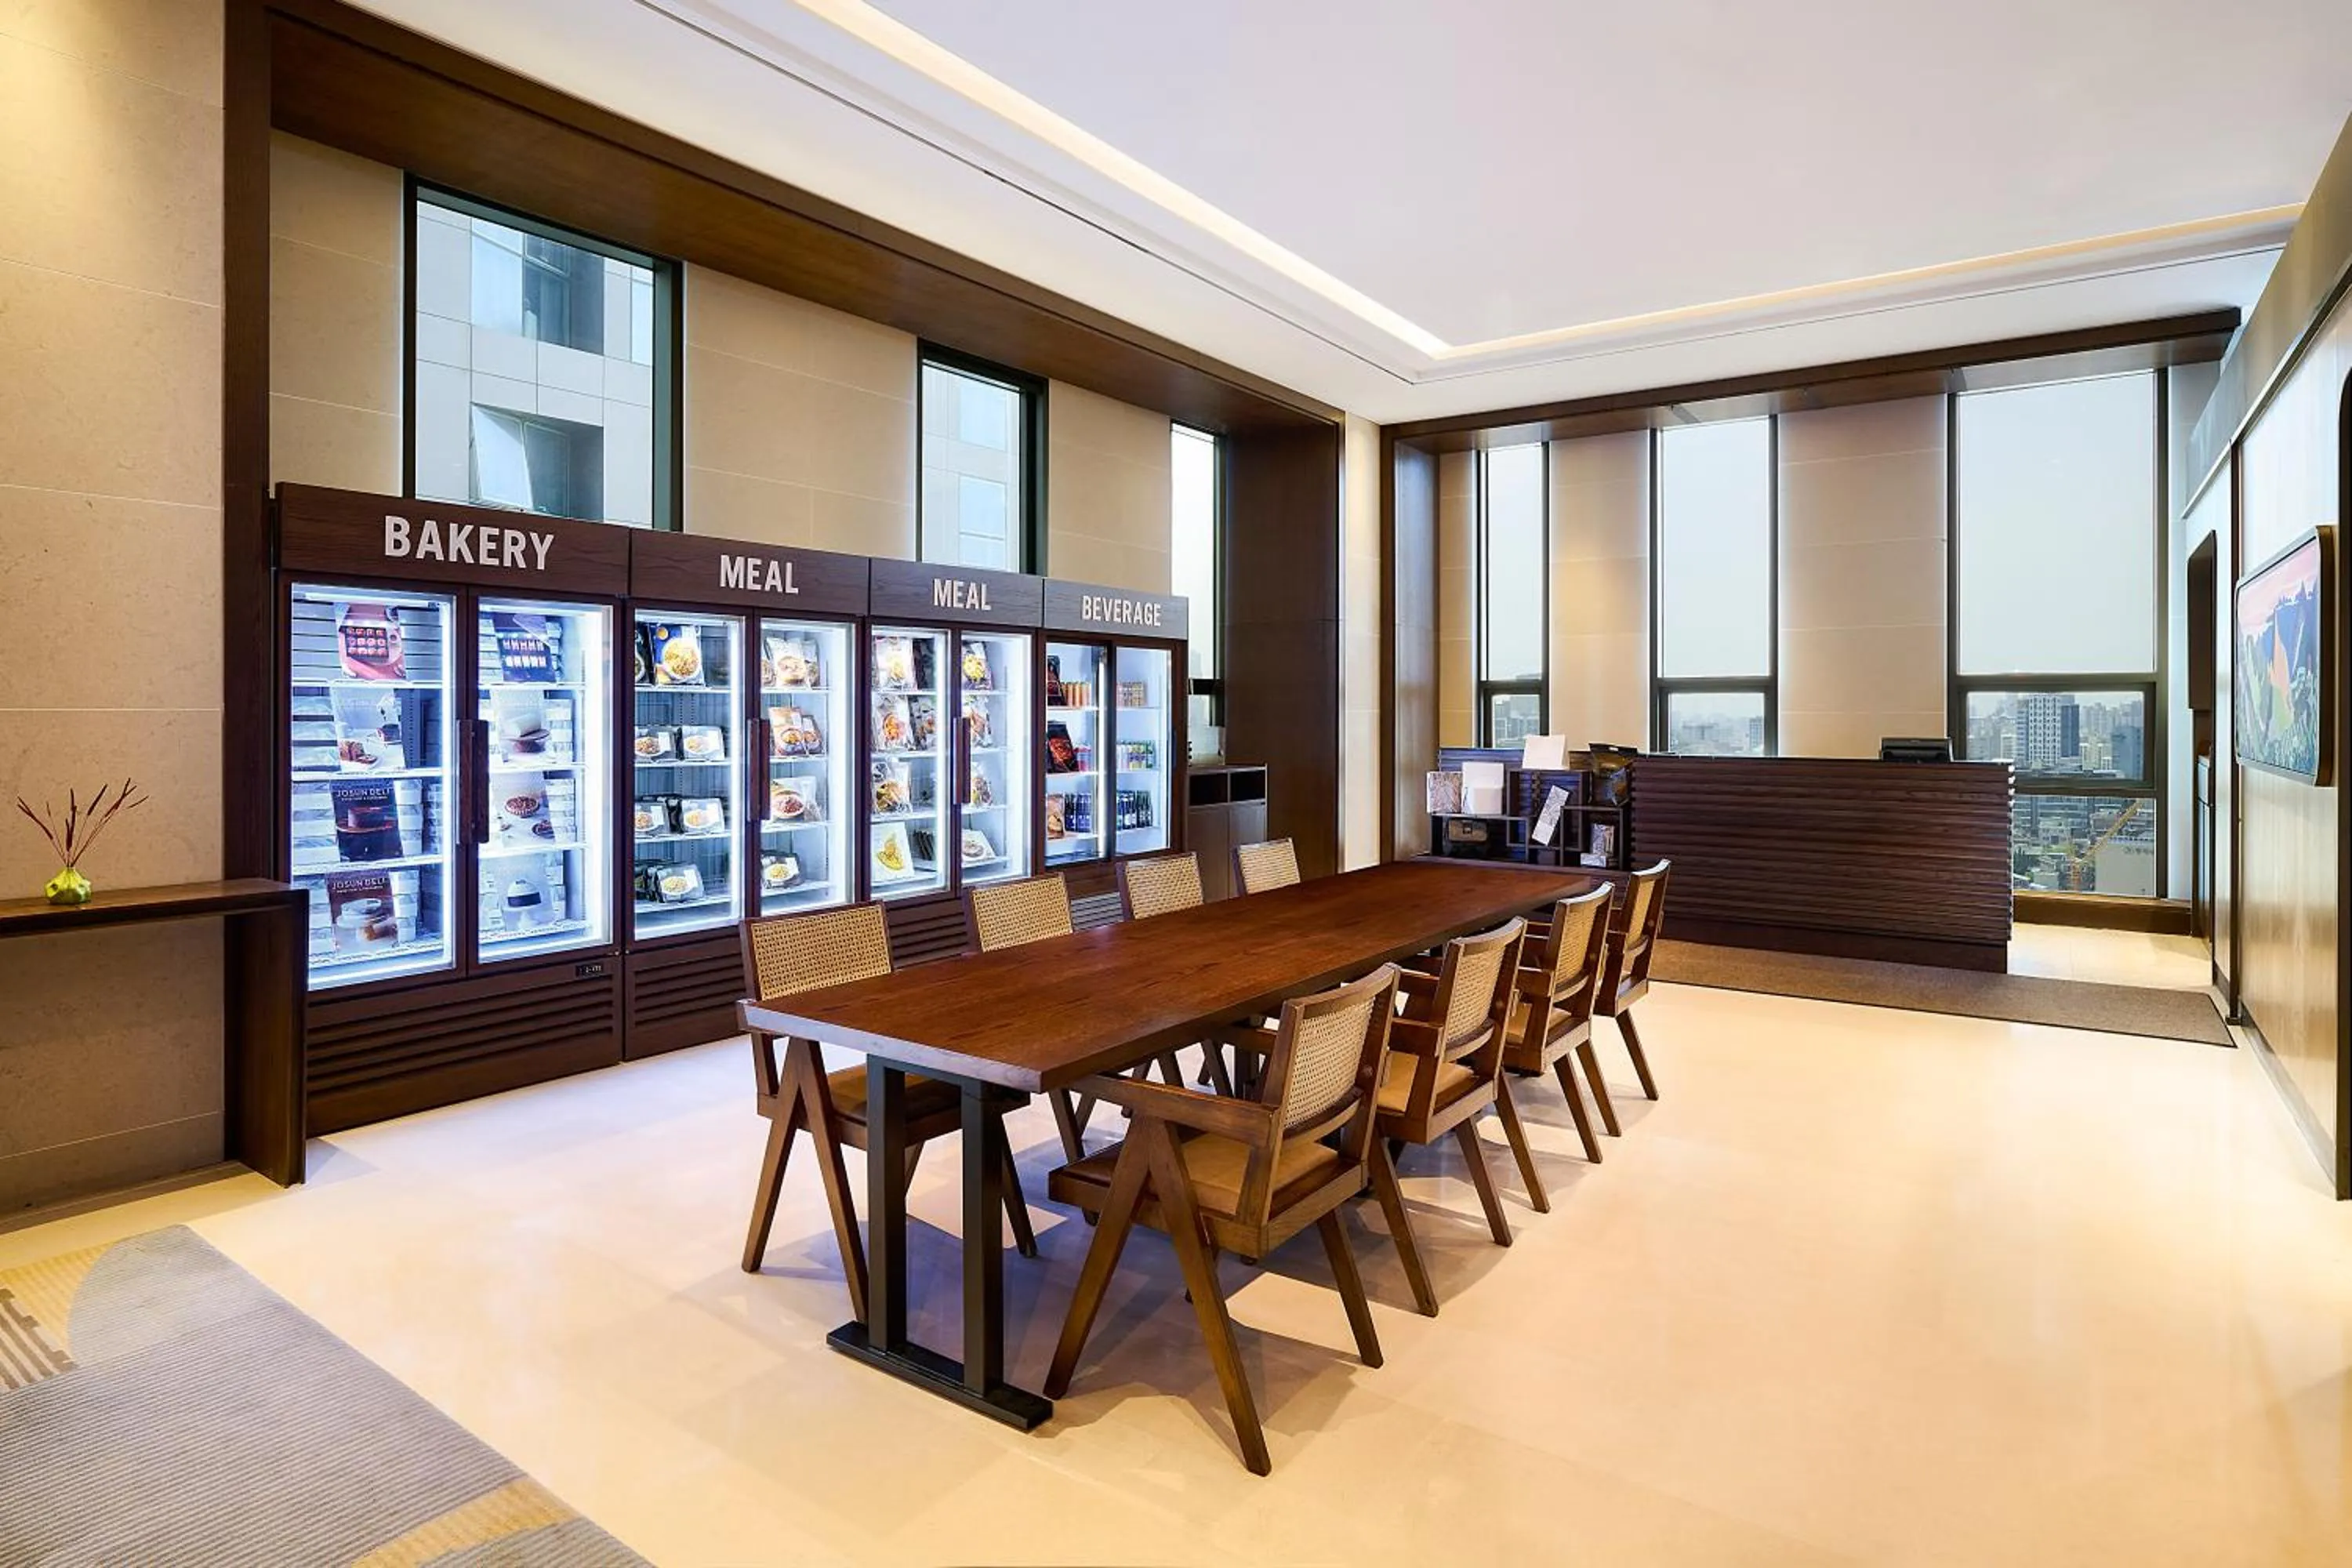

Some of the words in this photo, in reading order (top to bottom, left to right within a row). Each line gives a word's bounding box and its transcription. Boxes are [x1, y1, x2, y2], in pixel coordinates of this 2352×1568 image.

[385, 515, 554, 571] BAKERY
[720, 554, 799, 594] MEAL
[934, 579, 992, 611] MEAL
[1082, 596, 1161, 626] BEVERAGE
[336, 789, 368, 798] JOSUN
[332, 879, 363, 890] JOSUN
[365, 877, 385, 886] DELI
